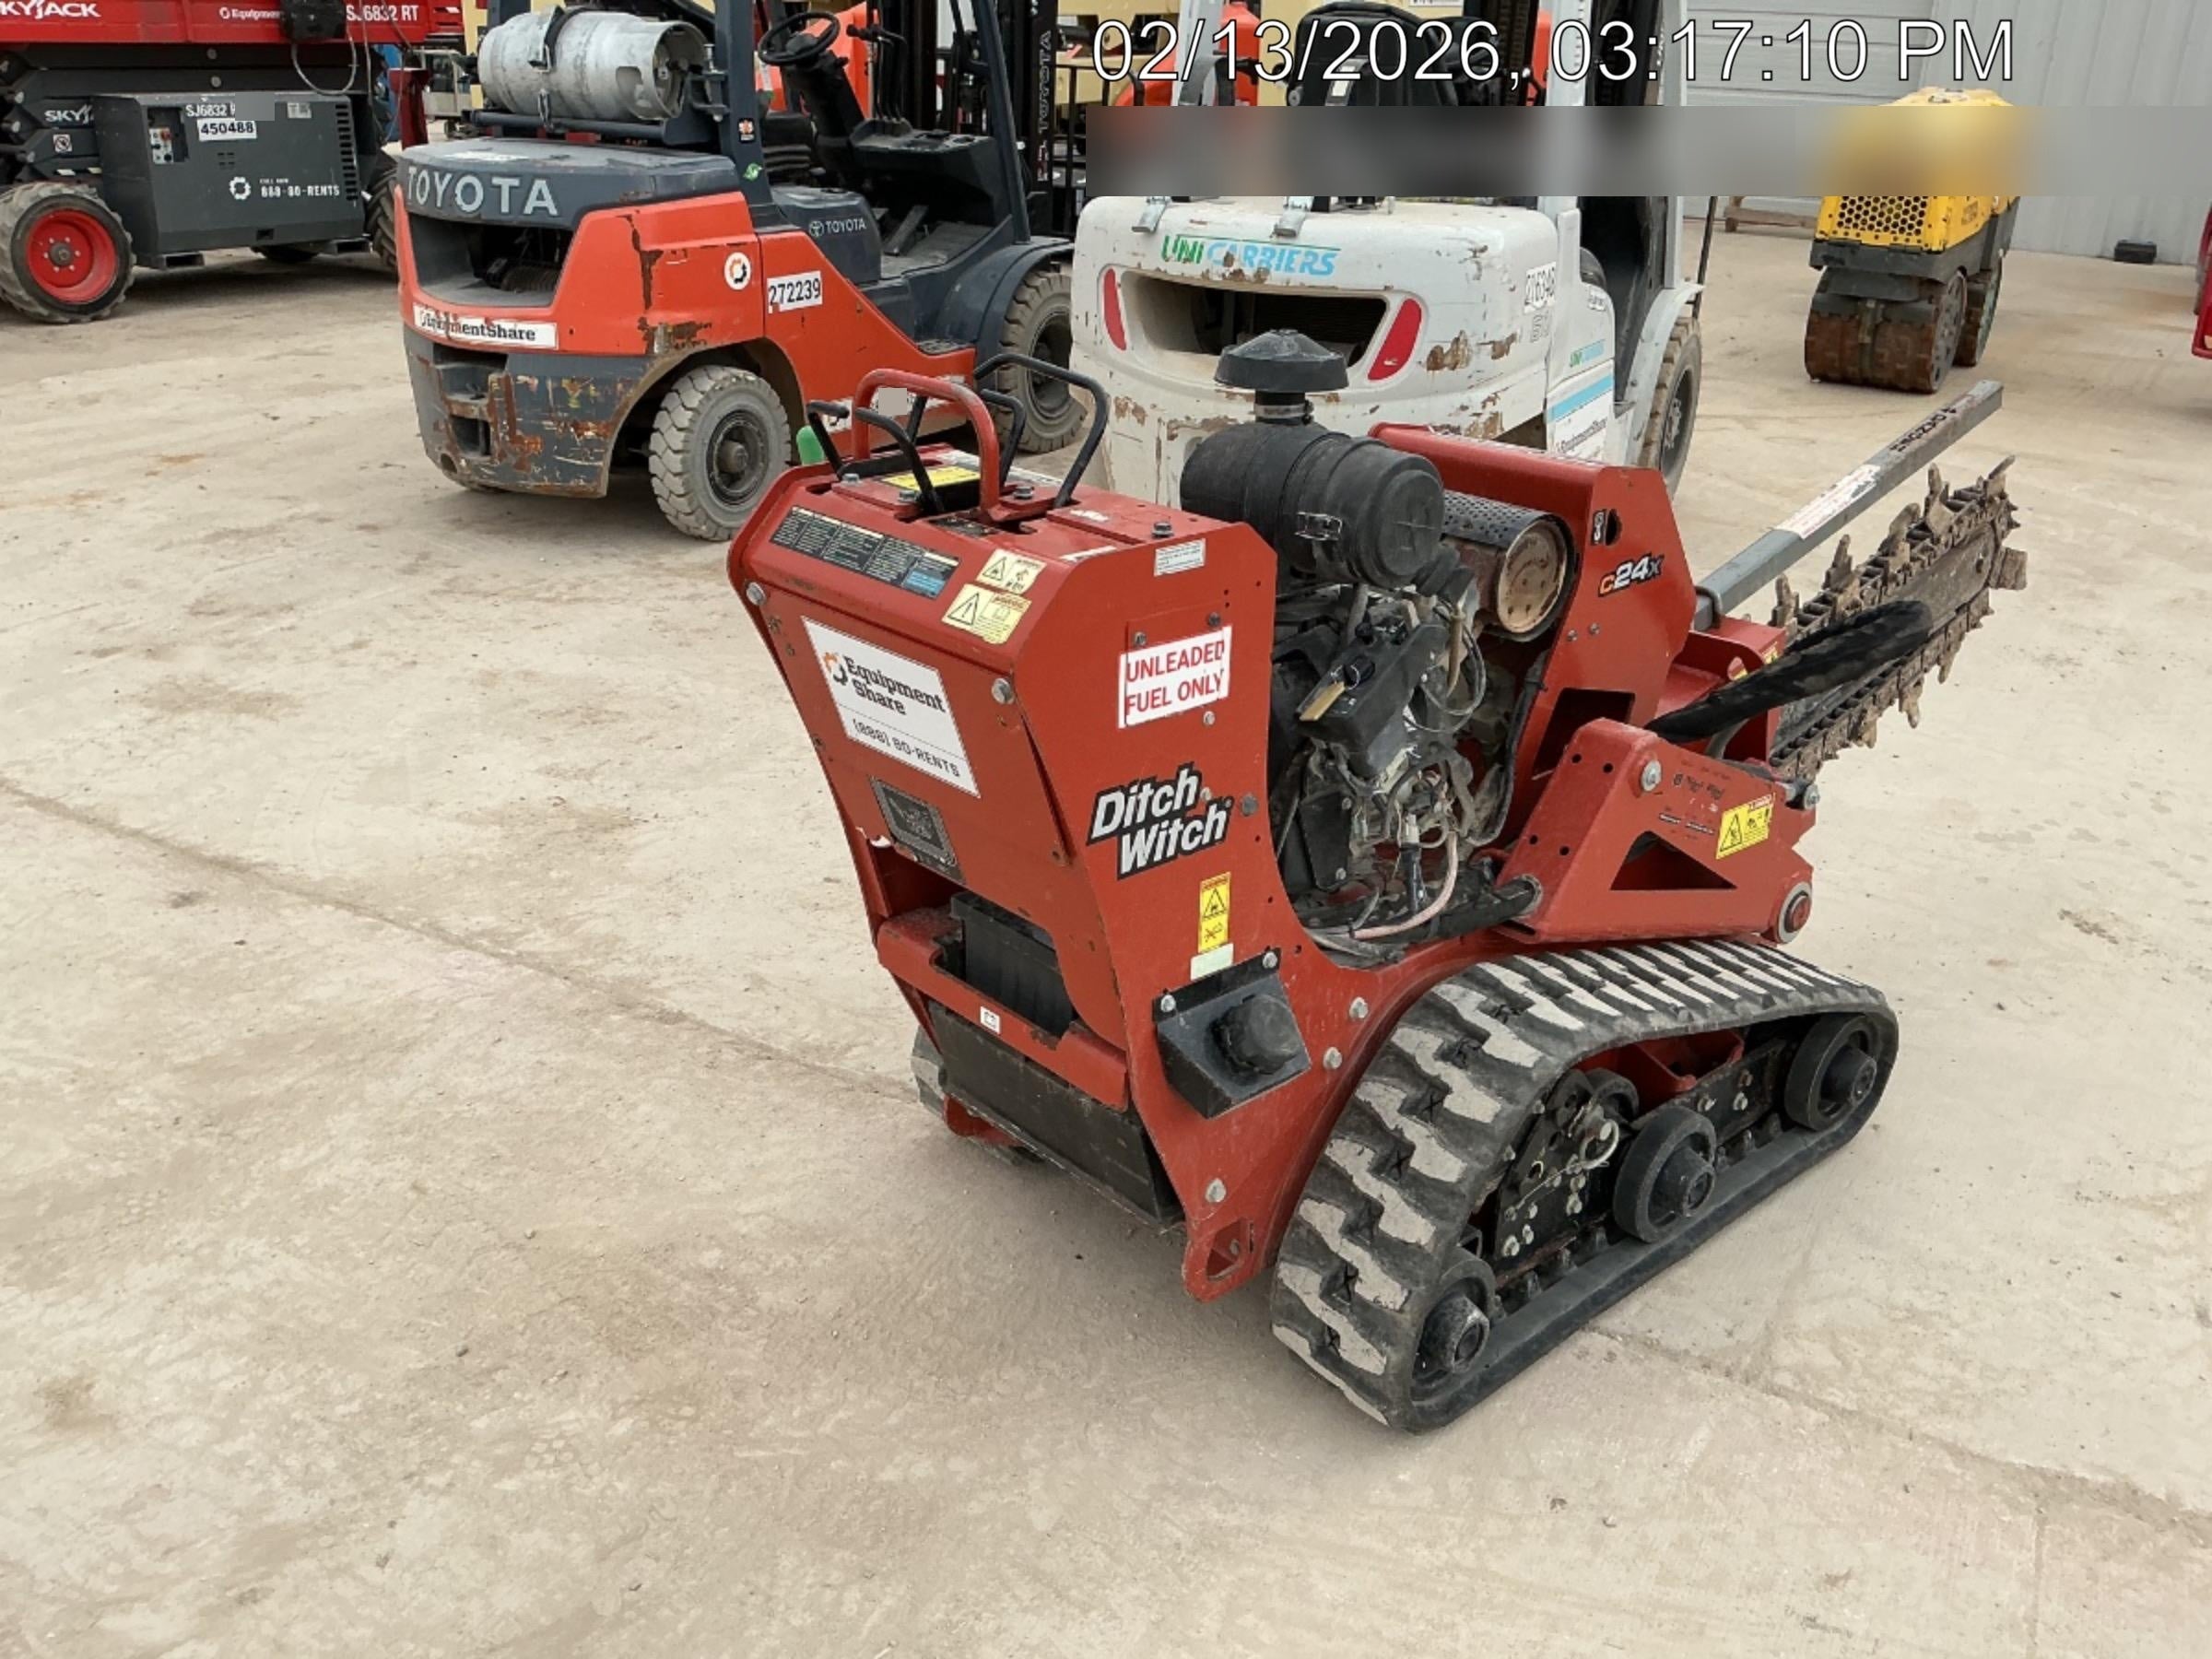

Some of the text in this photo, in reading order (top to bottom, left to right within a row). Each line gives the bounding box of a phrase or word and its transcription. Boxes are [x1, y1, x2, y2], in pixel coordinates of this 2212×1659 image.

[0, 0, 100, 18] KYJACK
[401, 6, 418, 21] RT
[44, 104, 93, 124] SKYJ
[185, 103, 228, 117] SJ6832
[200, 122, 254, 135] 450488
[407, 165, 559, 217] TOYOTA
[825, 218, 867, 233] TOYOTA
[769, 277, 821, 306] 272239
[1126, 640, 1225, 682] UNLEADED
[843, 655, 946, 713] Equipment
[852, 677, 907, 715] Share
[1125, 669, 1224, 716] FUEL ONLY
[1088, 766, 1200, 841] Ditch
[1120, 802, 1228, 875] Witch
